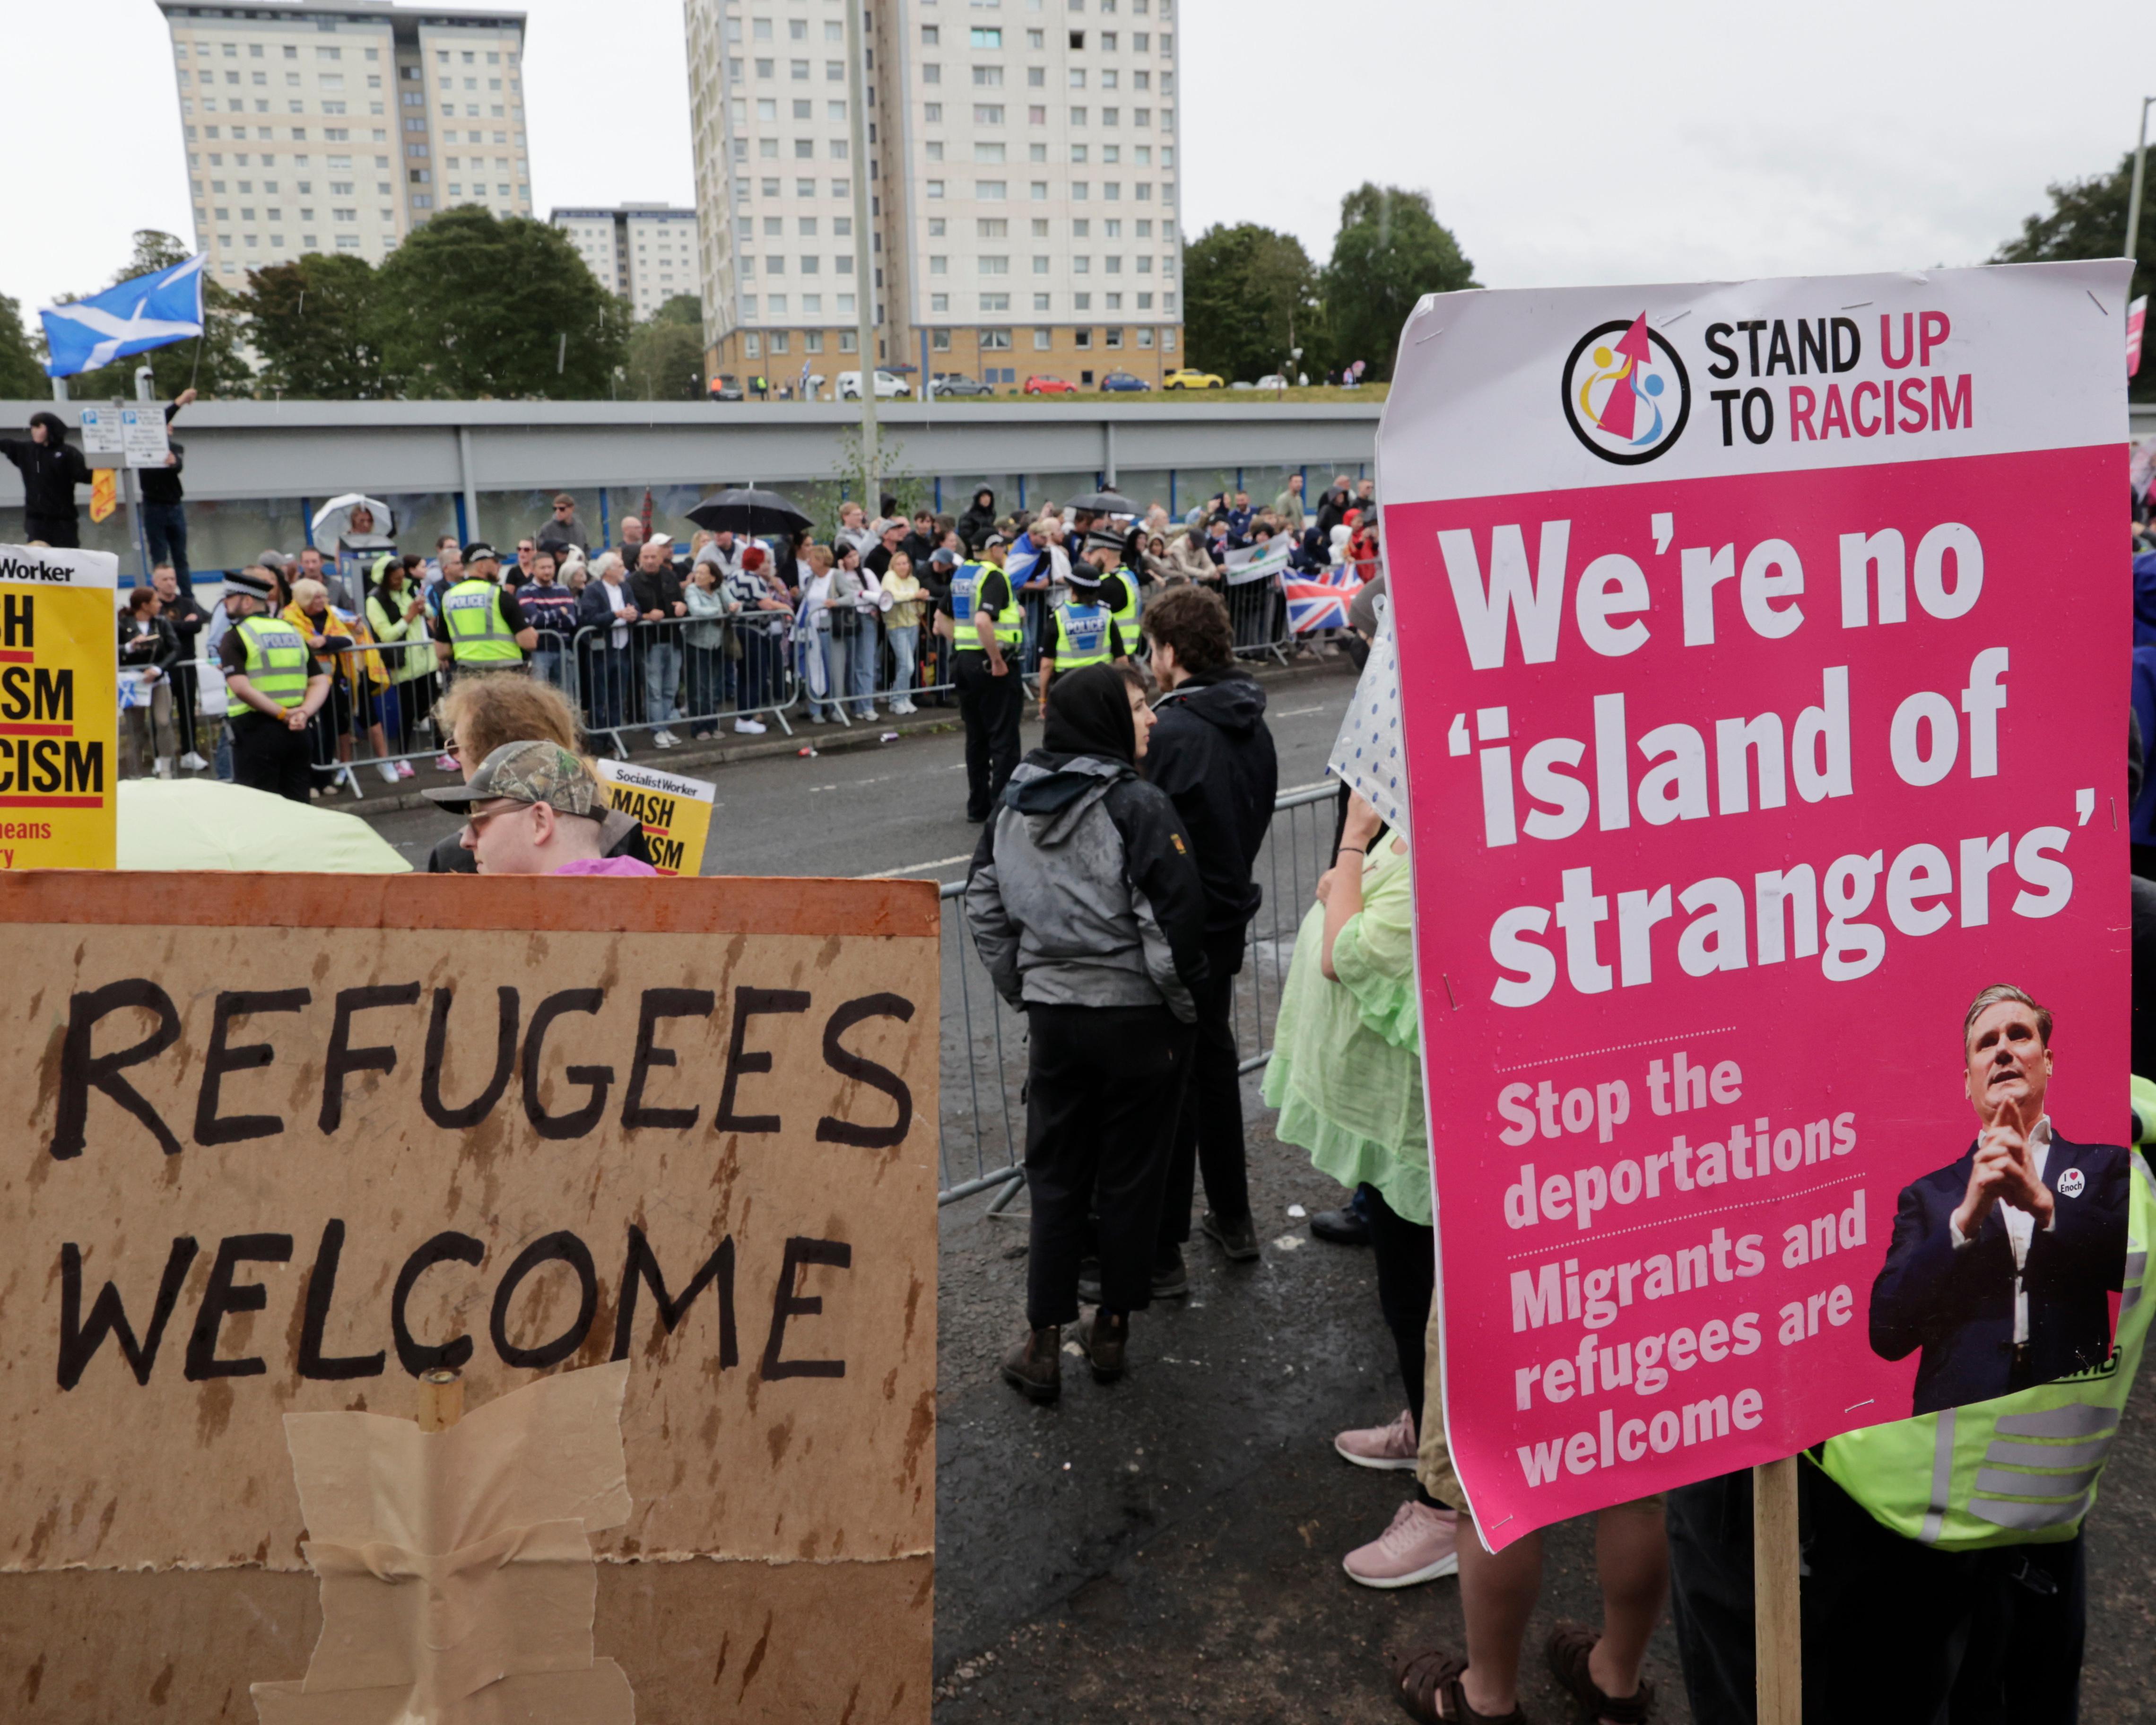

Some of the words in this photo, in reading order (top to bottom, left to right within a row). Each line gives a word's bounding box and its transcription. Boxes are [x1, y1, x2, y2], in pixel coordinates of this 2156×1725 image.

[1704, 317, 1861, 380] STAND
[1880, 311, 1950, 369] UP
[1710, 387, 1774, 447] TO
[1789, 374, 1973, 442] RACISM
[450, 595, 485, 609] POLICE
[1066, 619, 1104, 634] POLICE
[1437, 513, 1805, 671] We're
[1839, 522, 1984, 629] no
[263, 634, 300, 647] POLICE
[1448, 665, 1854, 848] 'island
[1890, 646, 2009, 787] of
[607, 785, 675, 828] MASH
[645, 835, 684, 869] SM
[1489, 787, 2095, 1008] strangers'
[49, 978, 915, 1160] REFUGEES
[1497, 1079, 1630, 1147] Stop
[1646, 1051, 1742, 1116] the
[1504, 1112, 1856, 1230] deportations
[2060, 1181, 2082, 1193] Enoch
[2064, 1173, 2067, 1182] I
[57, 1218, 852, 1392] WELCOME
[1510, 1227, 1765, 1333] Migrants
[1782, 1188, 1867, 1269] and
[1515, 1312, 1762, 1411] refugees
[1778, 1284, 1853, 1346] are
[1516, 1388, 1763, 1488] welcome
